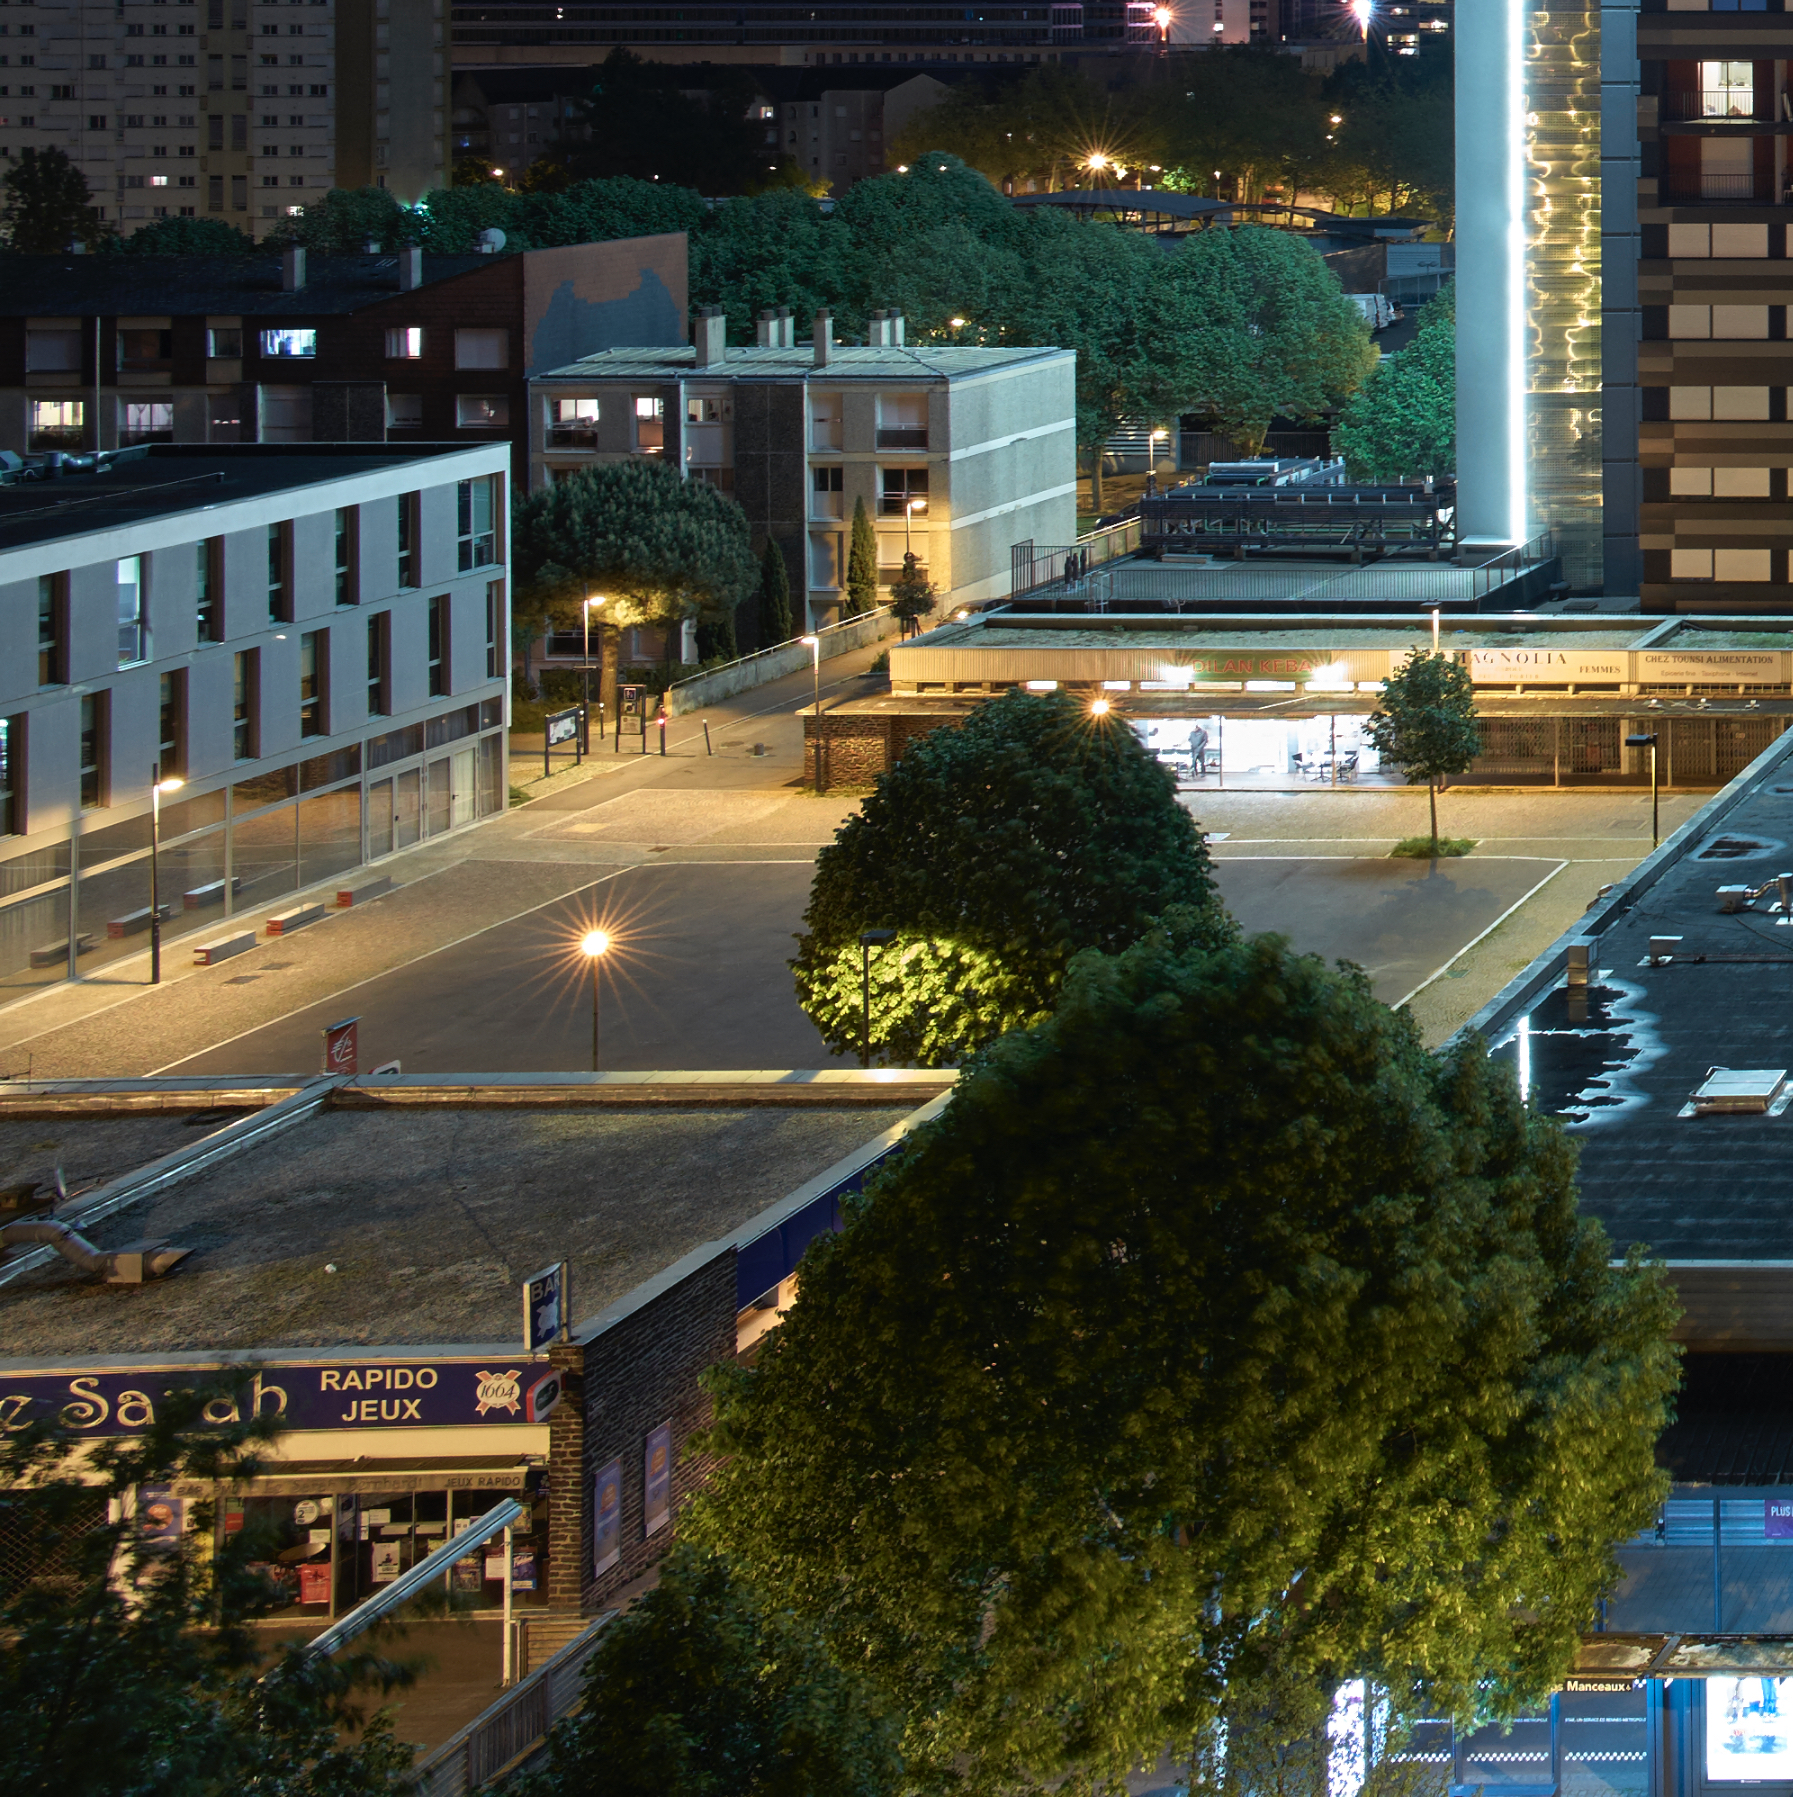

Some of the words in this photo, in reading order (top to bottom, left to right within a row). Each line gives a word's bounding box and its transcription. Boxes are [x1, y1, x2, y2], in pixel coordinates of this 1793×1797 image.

[1192, 659, 1252, 673] DILAN
[1645, 655, 1669, 664] CHEZ
[1672, 655, 1704, 664] TOUNSI
[1706, 655, 1773, 664] ALIMENTATION
[1579, 665, 1621, 674] FEMMES
[530, 1270, 561, 1303] BAR
[320, 1367, 438, 1391] RAPIDO
[481, 1381, 515, 1399] 1664
[58, 1370, 288, 1429] Saah
[341, 1398, 422, 1421] JEUX
[445, 1477, 473, 1488] JEUX
[478, 1476, 521, 1487] RAPIDO
[1771, 1506, 1791, 1517] PLUS
[1566, 1680, 1626, 1692] Manceaux
